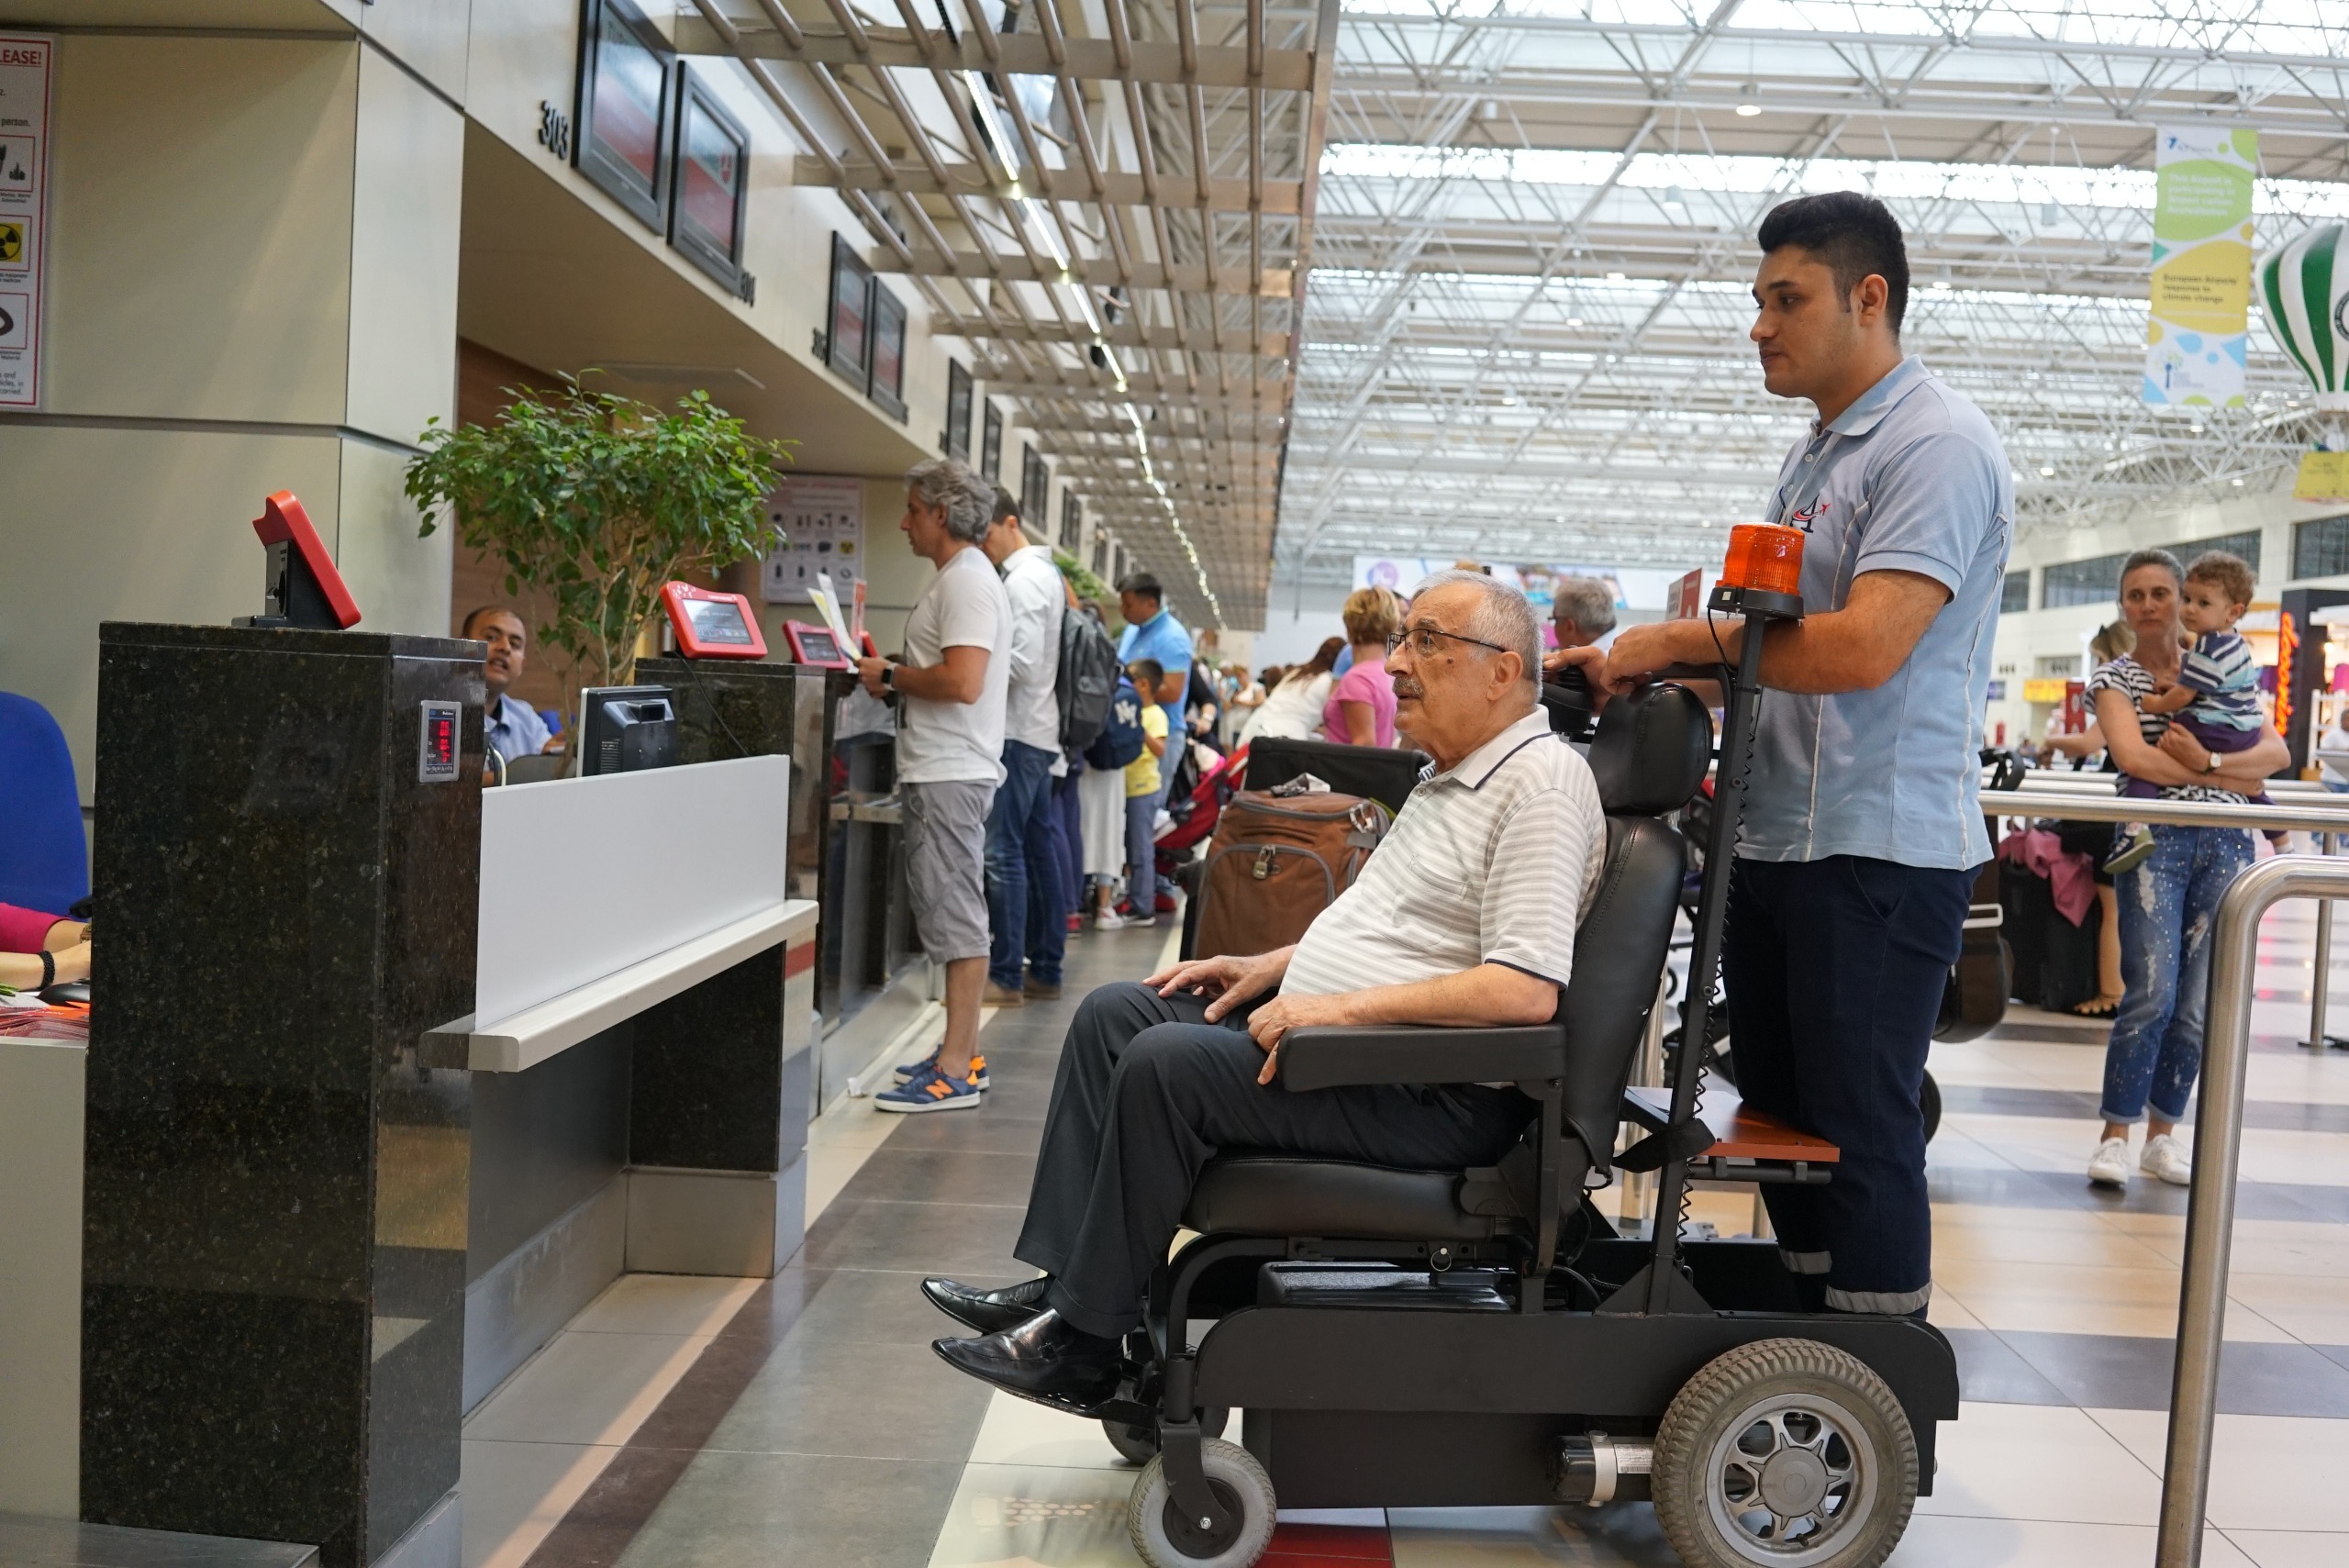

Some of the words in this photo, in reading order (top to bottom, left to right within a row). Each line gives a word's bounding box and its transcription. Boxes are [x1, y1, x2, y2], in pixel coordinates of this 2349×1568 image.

[0, 49, 42, 65] EASE!
[1, 118, 31, 127] person.
[539, 99, 568, 161] 303
[2163, 274, 2203, 284] European
[2164, 284, 2200, 293] response
[2162, 294, 2192, 302] climate
[2194, 294, 2224, 305] change
